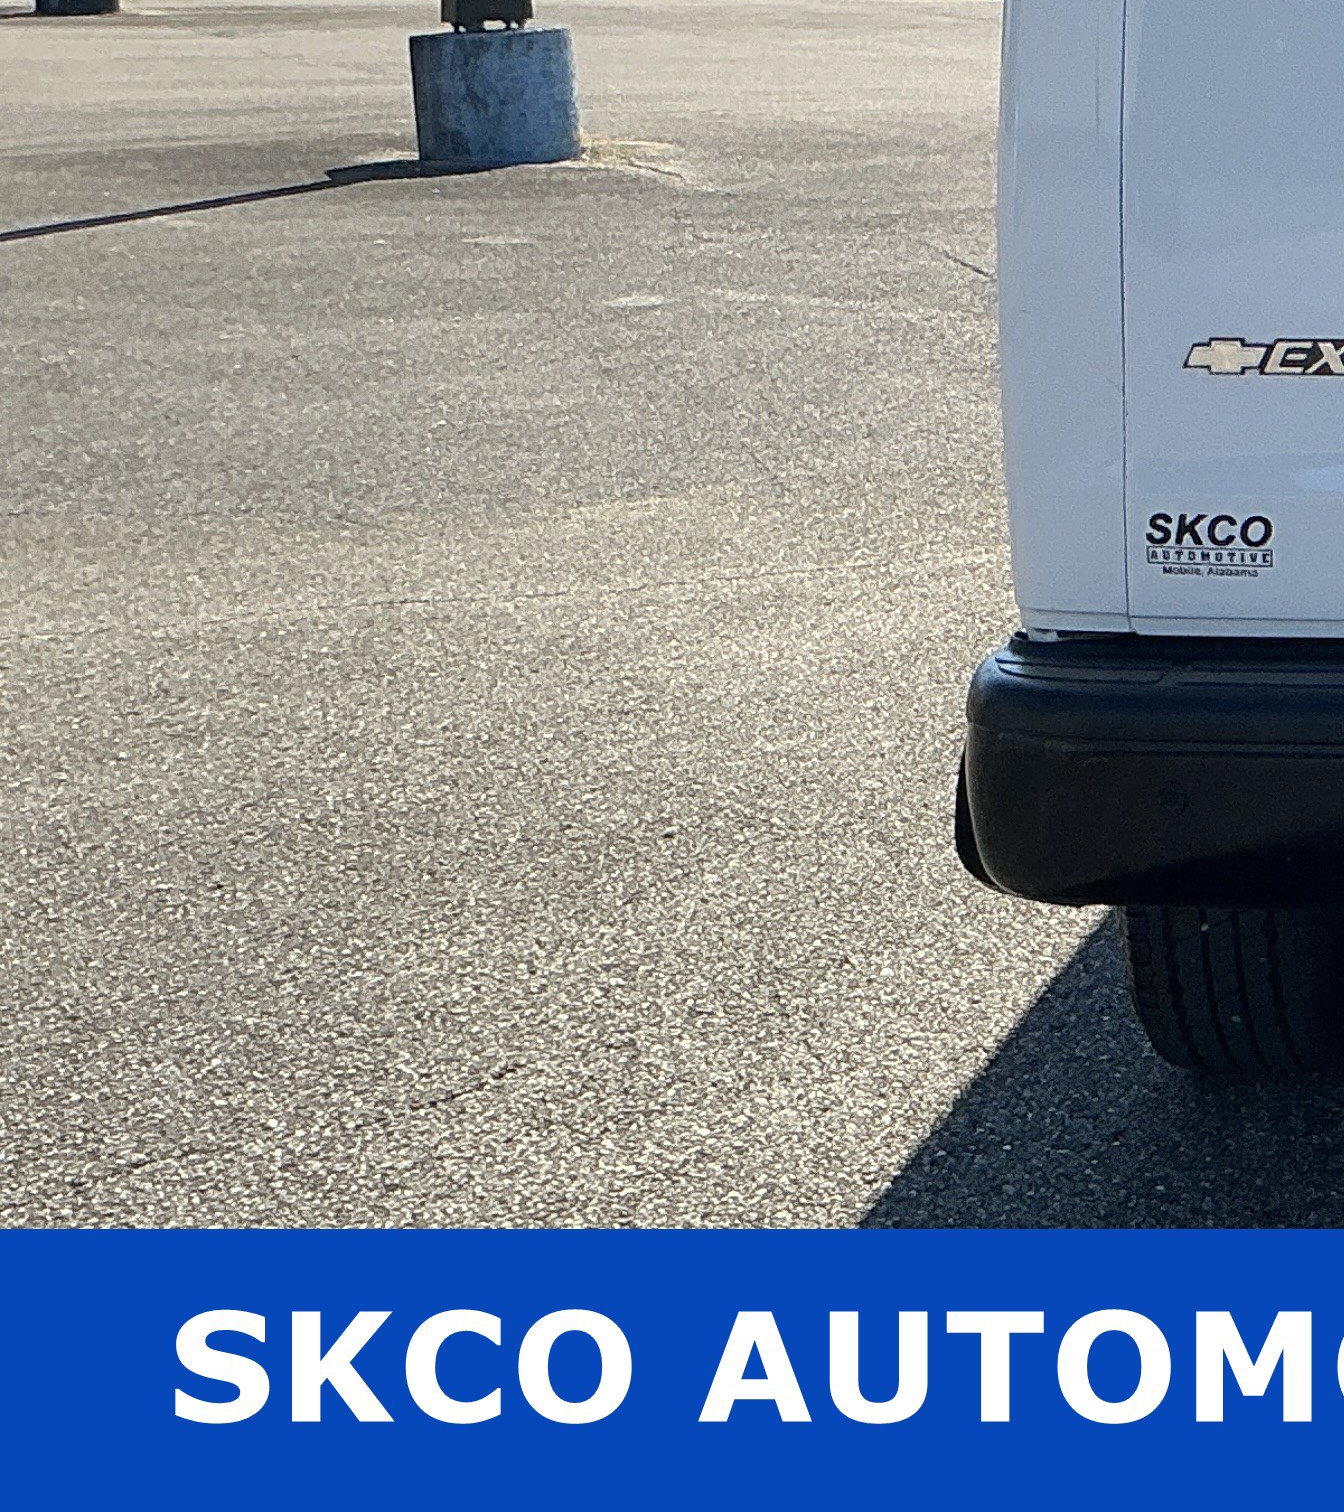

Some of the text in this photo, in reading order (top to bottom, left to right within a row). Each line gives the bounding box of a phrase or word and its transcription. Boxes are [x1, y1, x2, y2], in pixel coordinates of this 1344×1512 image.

[1146, 512, 1274, 547] SKCO
[1150, 550, 1271, 564] AUTOMOTIVE
[1207, 567, 1259, 578] Alabama
